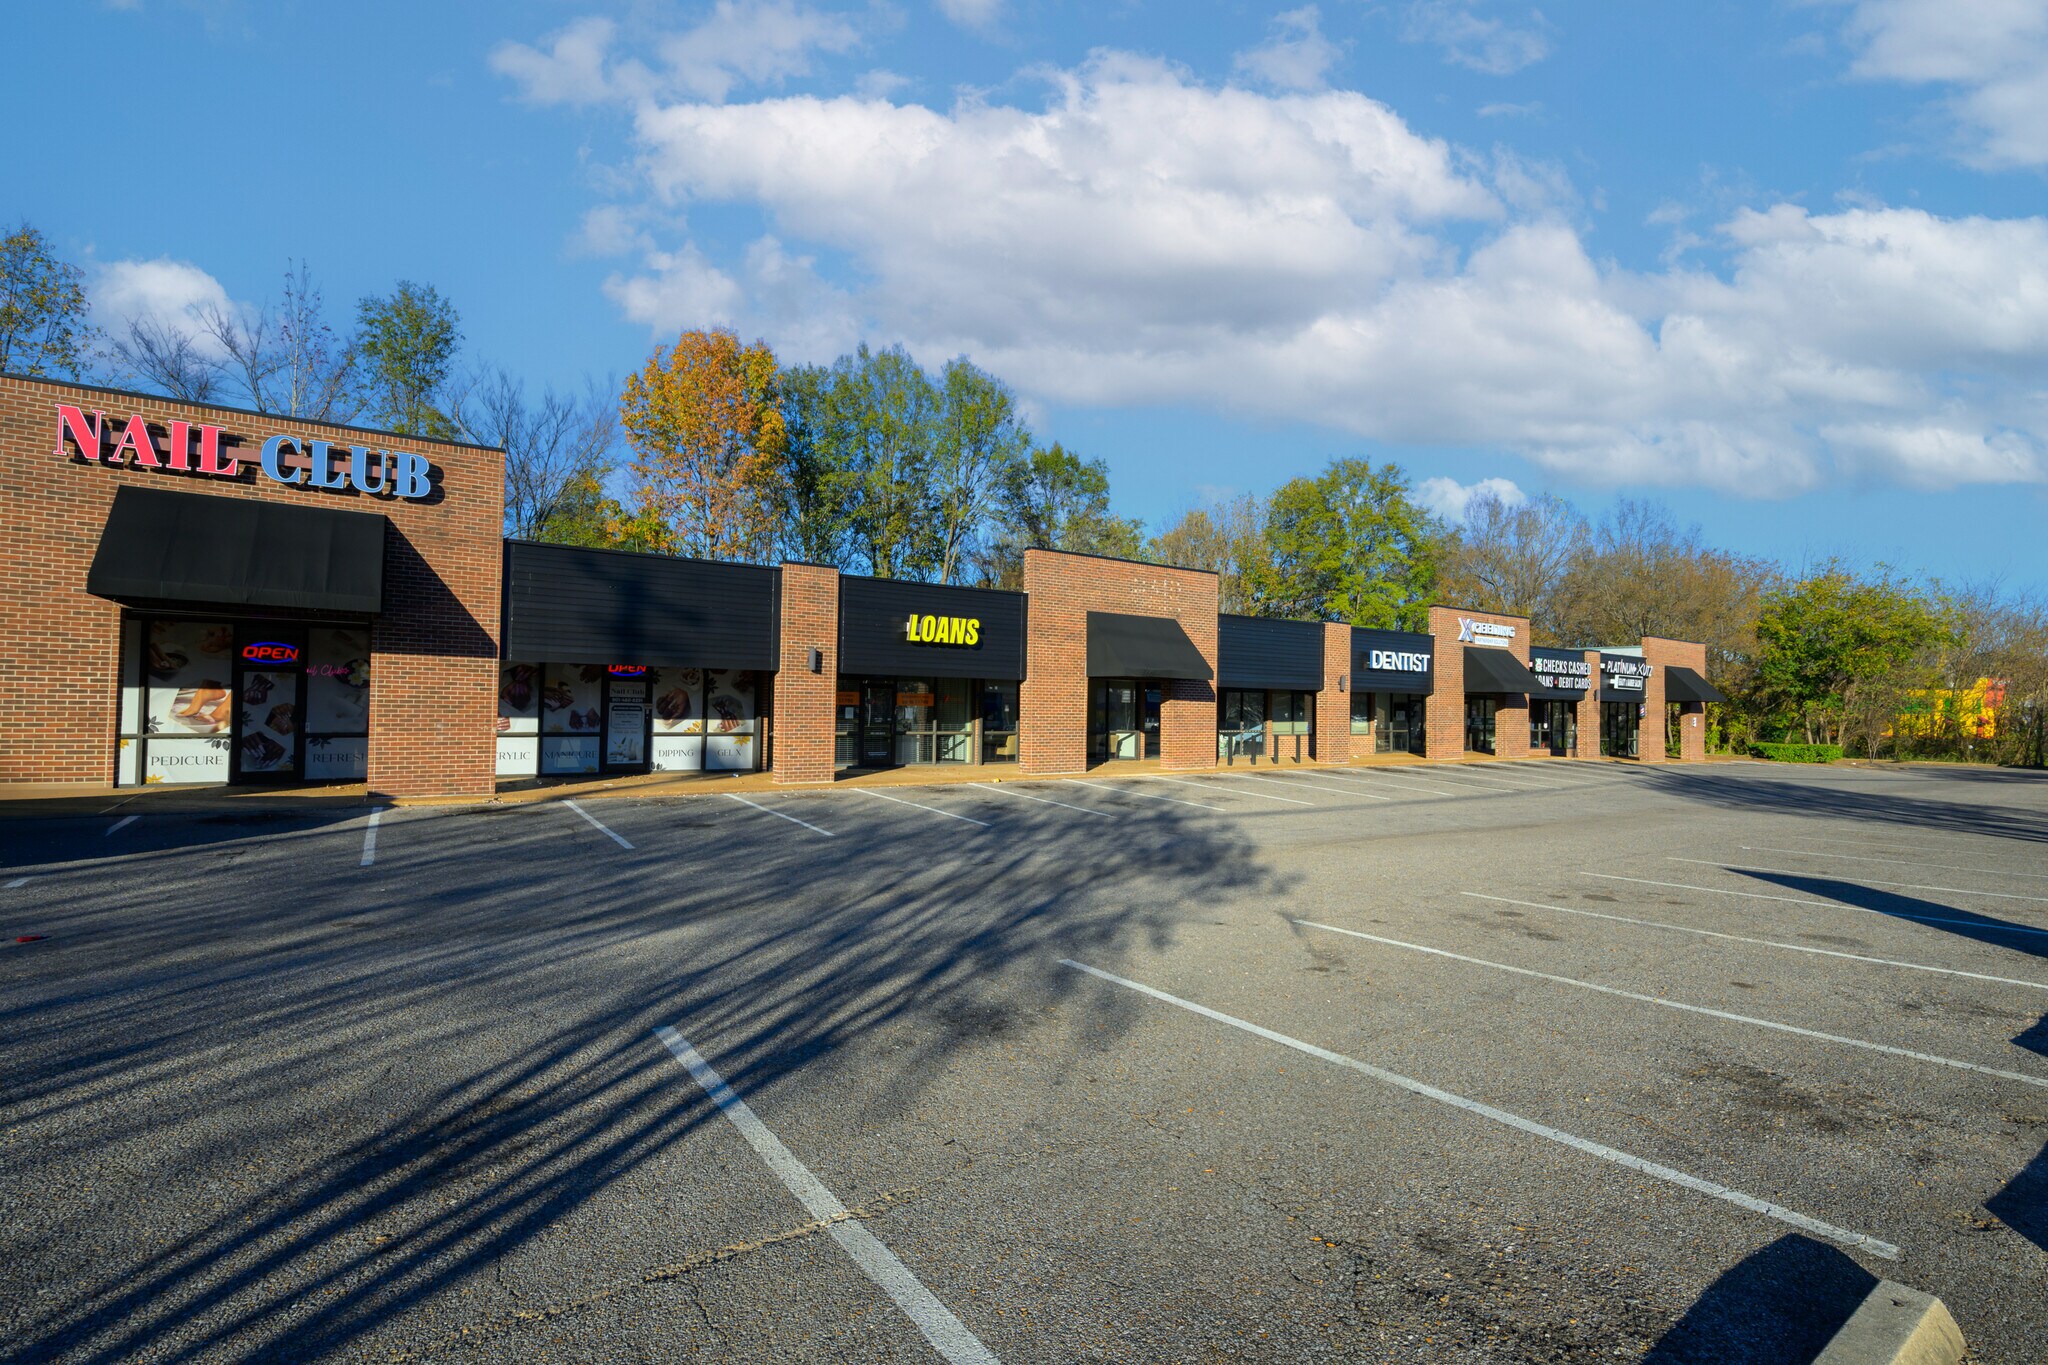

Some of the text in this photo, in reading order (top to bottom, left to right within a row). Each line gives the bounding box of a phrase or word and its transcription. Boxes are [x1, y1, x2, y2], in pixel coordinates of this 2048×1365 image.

[53, 403, 431, 498] NAIL CLUB
[907, 614, 980, 645] LOANS
[242, 646, 299, 661] OPEN
[1370, 650, 1430, 672] DENTIST
[1543, 659, 1592, 676] CHECKS CASHED
[1535, 675, 1592, 690] OANS DEBIT CARDS
[496, 751, 531, 761] RYLIC
[544, 750, 597, 760] MANICURE
[658, 749, 694, 758] DIPPING
[717, 748, 742, 757] GEL X
[151, 755, 224, 767] PEDICURE
